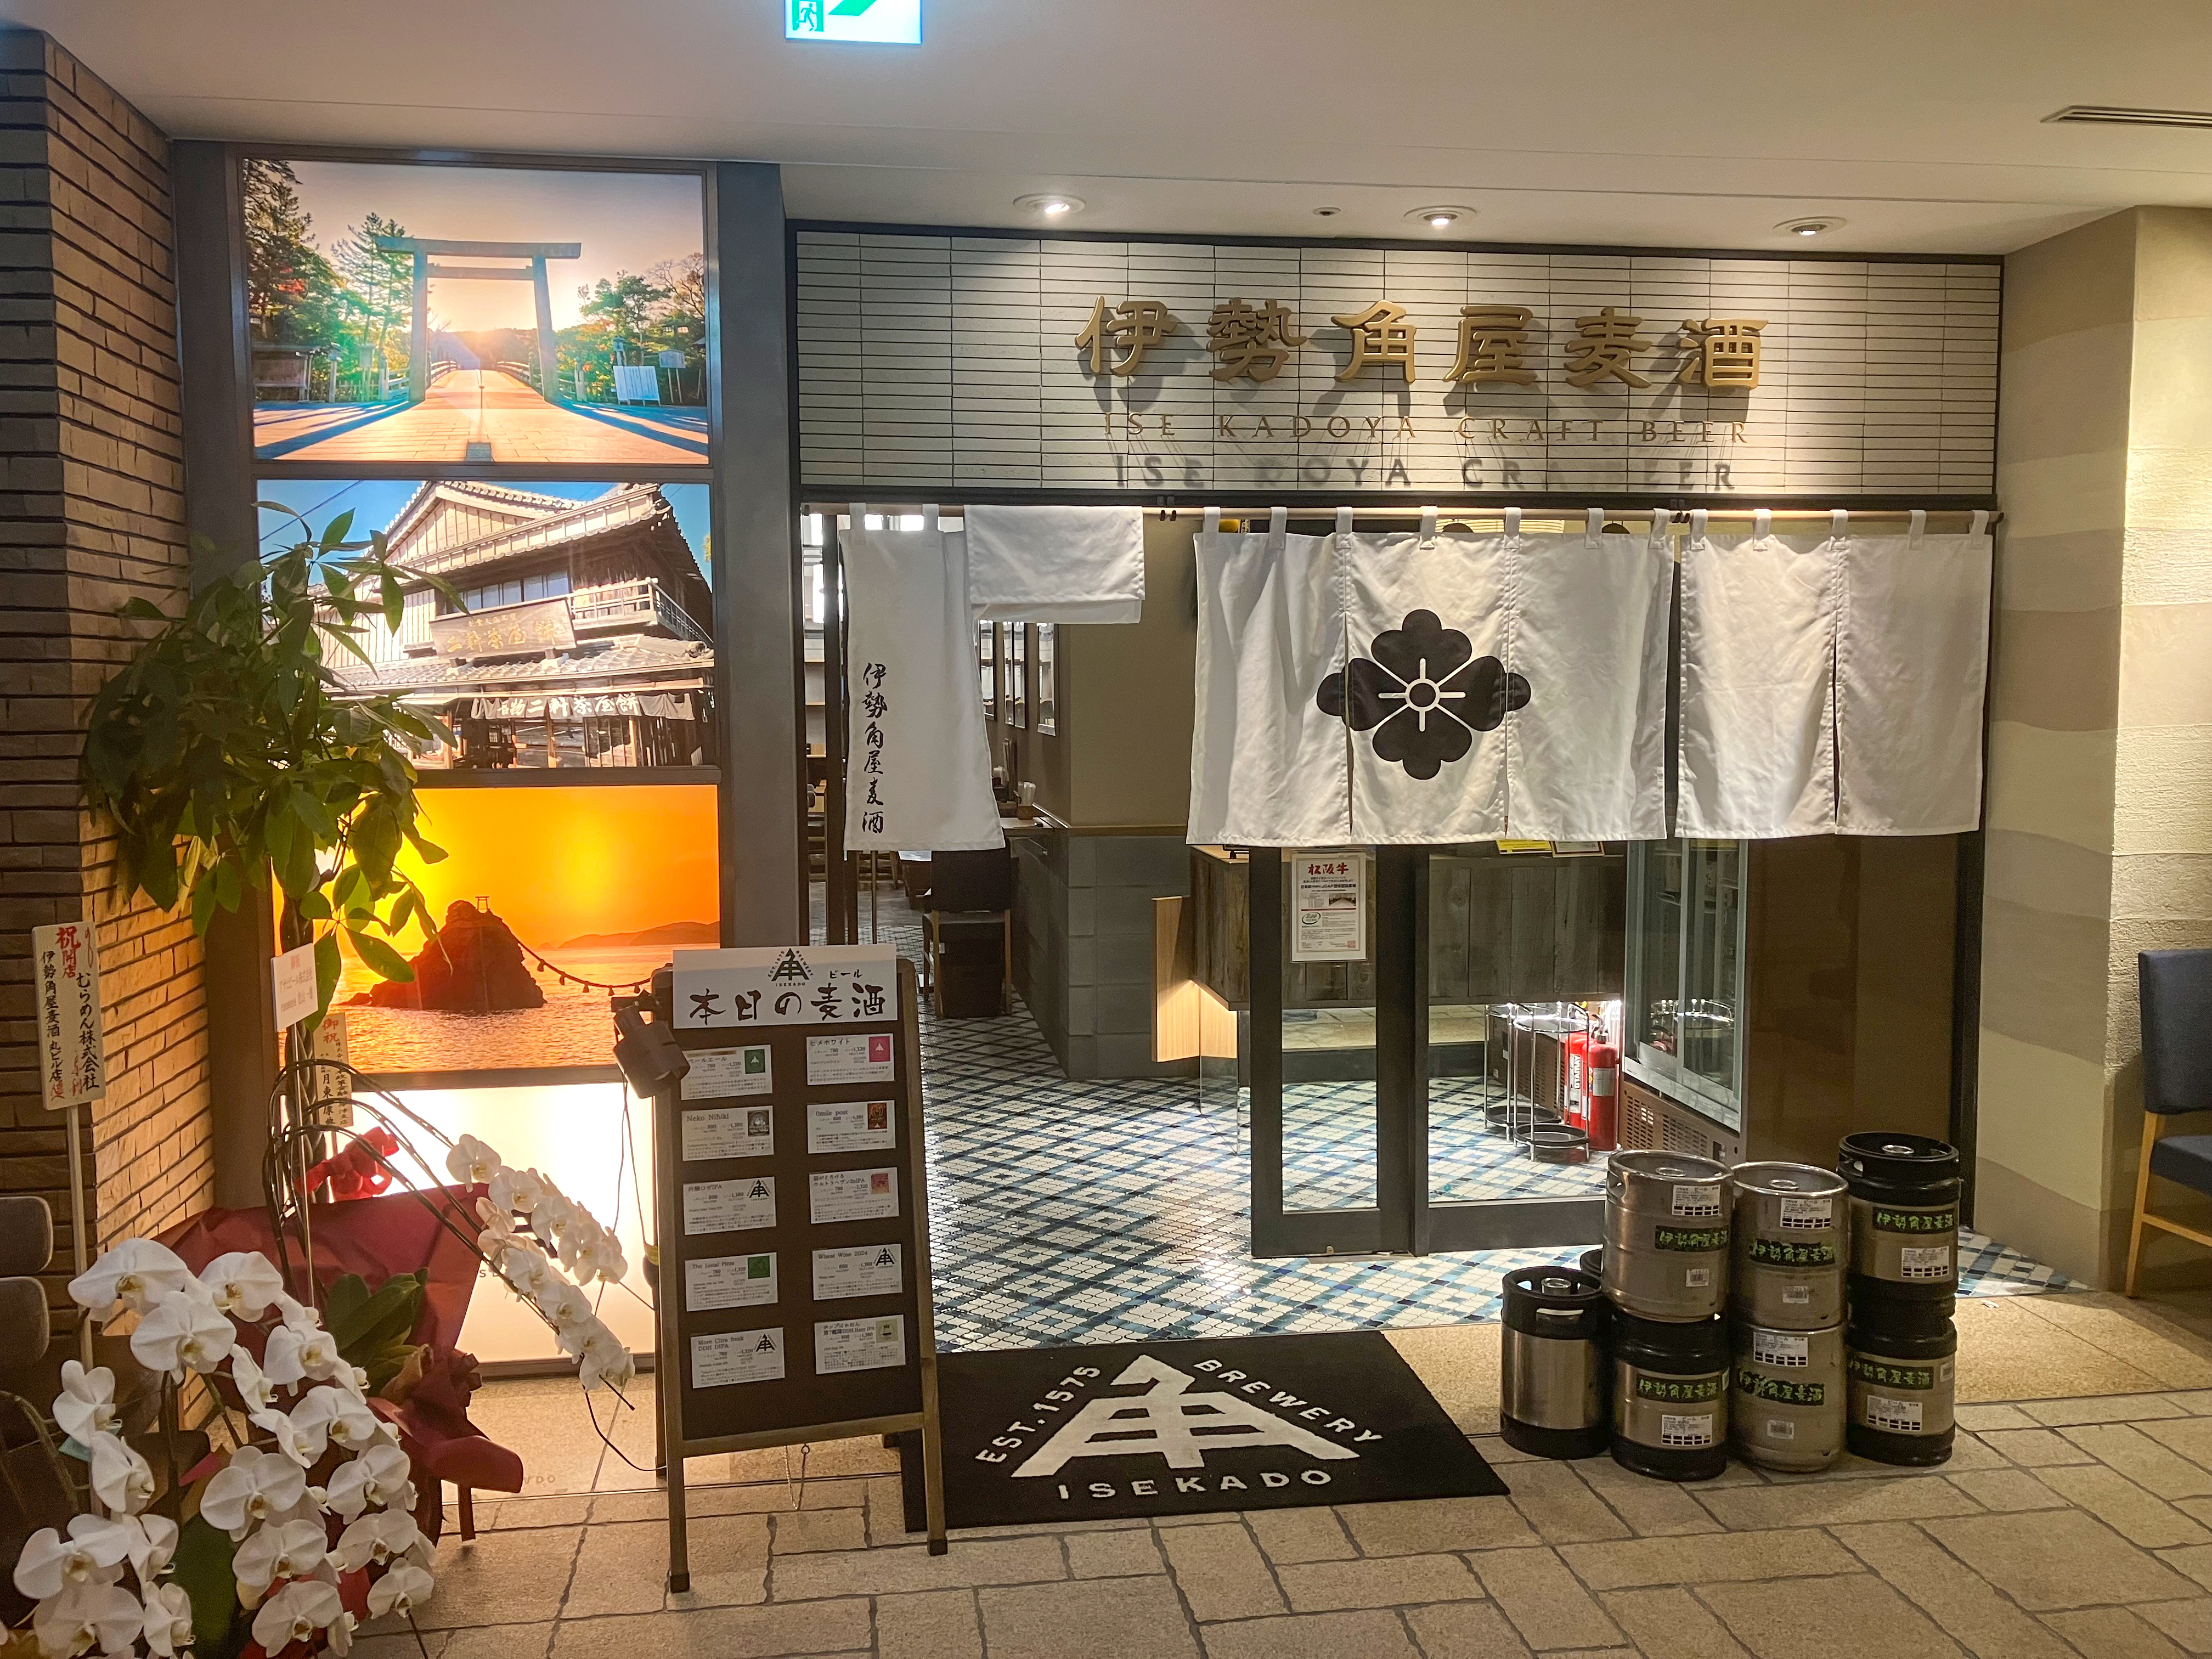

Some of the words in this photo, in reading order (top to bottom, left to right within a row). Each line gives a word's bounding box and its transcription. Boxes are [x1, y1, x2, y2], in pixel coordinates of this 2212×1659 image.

[1075, 296, 1768, 390] 伊勢角屋麦酒
[1104, 412, 1176, 436] ISE
[1218, 414, 1416, 438] KADOYA
[1457, 415, 1604, 442] CRAFT
[1641, 420, 1748, 444] BEER
[861, 662, 888, 834] 伊勢角屋麦酒
[41, 951, 60, 1039] 伊勢角屋麦酒
[690, 983, 886, 1025] 本日の麦酒
[830, 968, 864, 979] ビール
[76, 972, 100, 1092] むらめん株式会社
[321, 1018, 340, 1043] 御祝
[1193, 1359, 1383, 1442] BREWERY
[1058, 1470, 1331, 1499] ISEKADO
